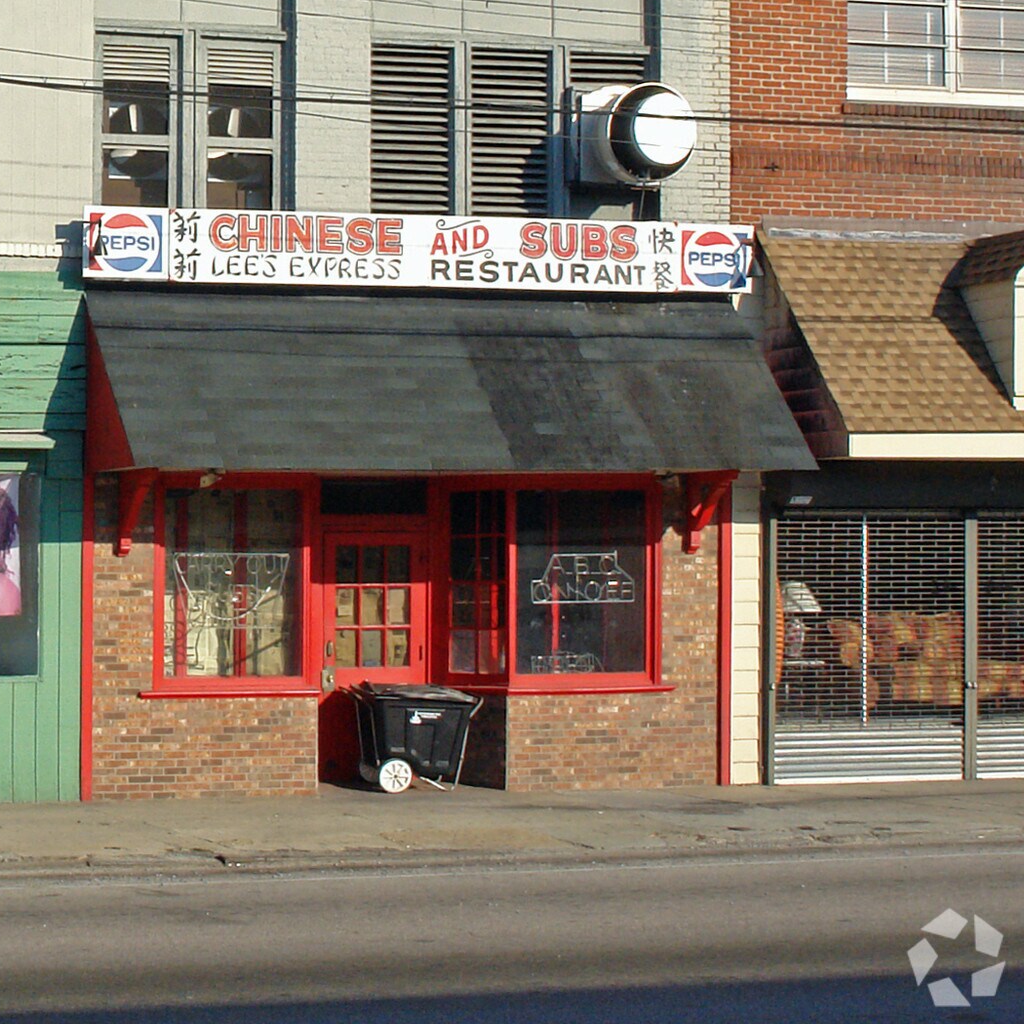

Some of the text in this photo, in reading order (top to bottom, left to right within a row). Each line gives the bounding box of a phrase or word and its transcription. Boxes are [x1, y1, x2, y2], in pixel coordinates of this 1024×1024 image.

[209, 213, 639, 263] CHINESE AND SUBS
[211, 254, 646, 286] LEE'S EXPRESS RESTAURANT
